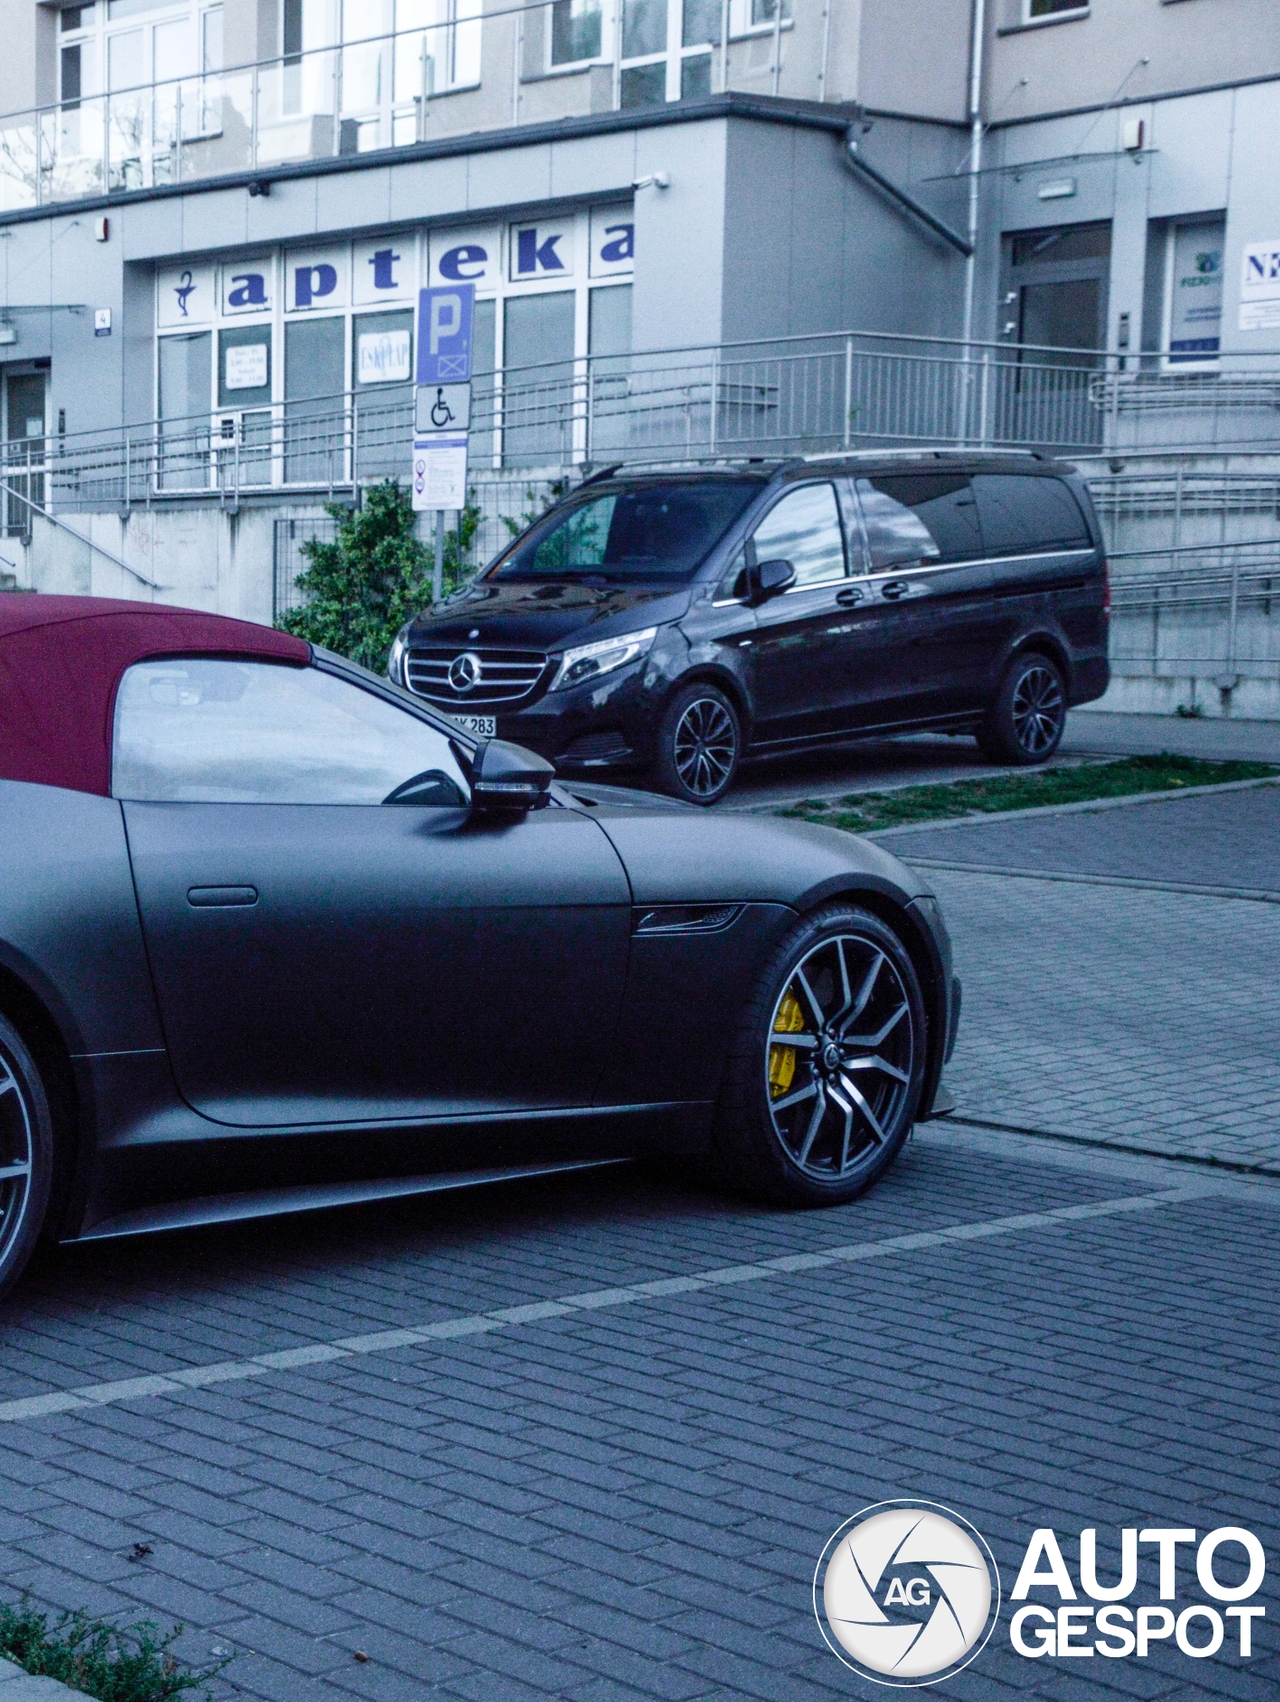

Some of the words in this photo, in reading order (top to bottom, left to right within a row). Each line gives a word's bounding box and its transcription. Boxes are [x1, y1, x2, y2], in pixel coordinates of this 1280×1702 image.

[228, 222, 634, 307] apteka
[100, 313, 106, 325] 4
[430, 293, 461, 355] P
[471, 718, 494, 734] 283
